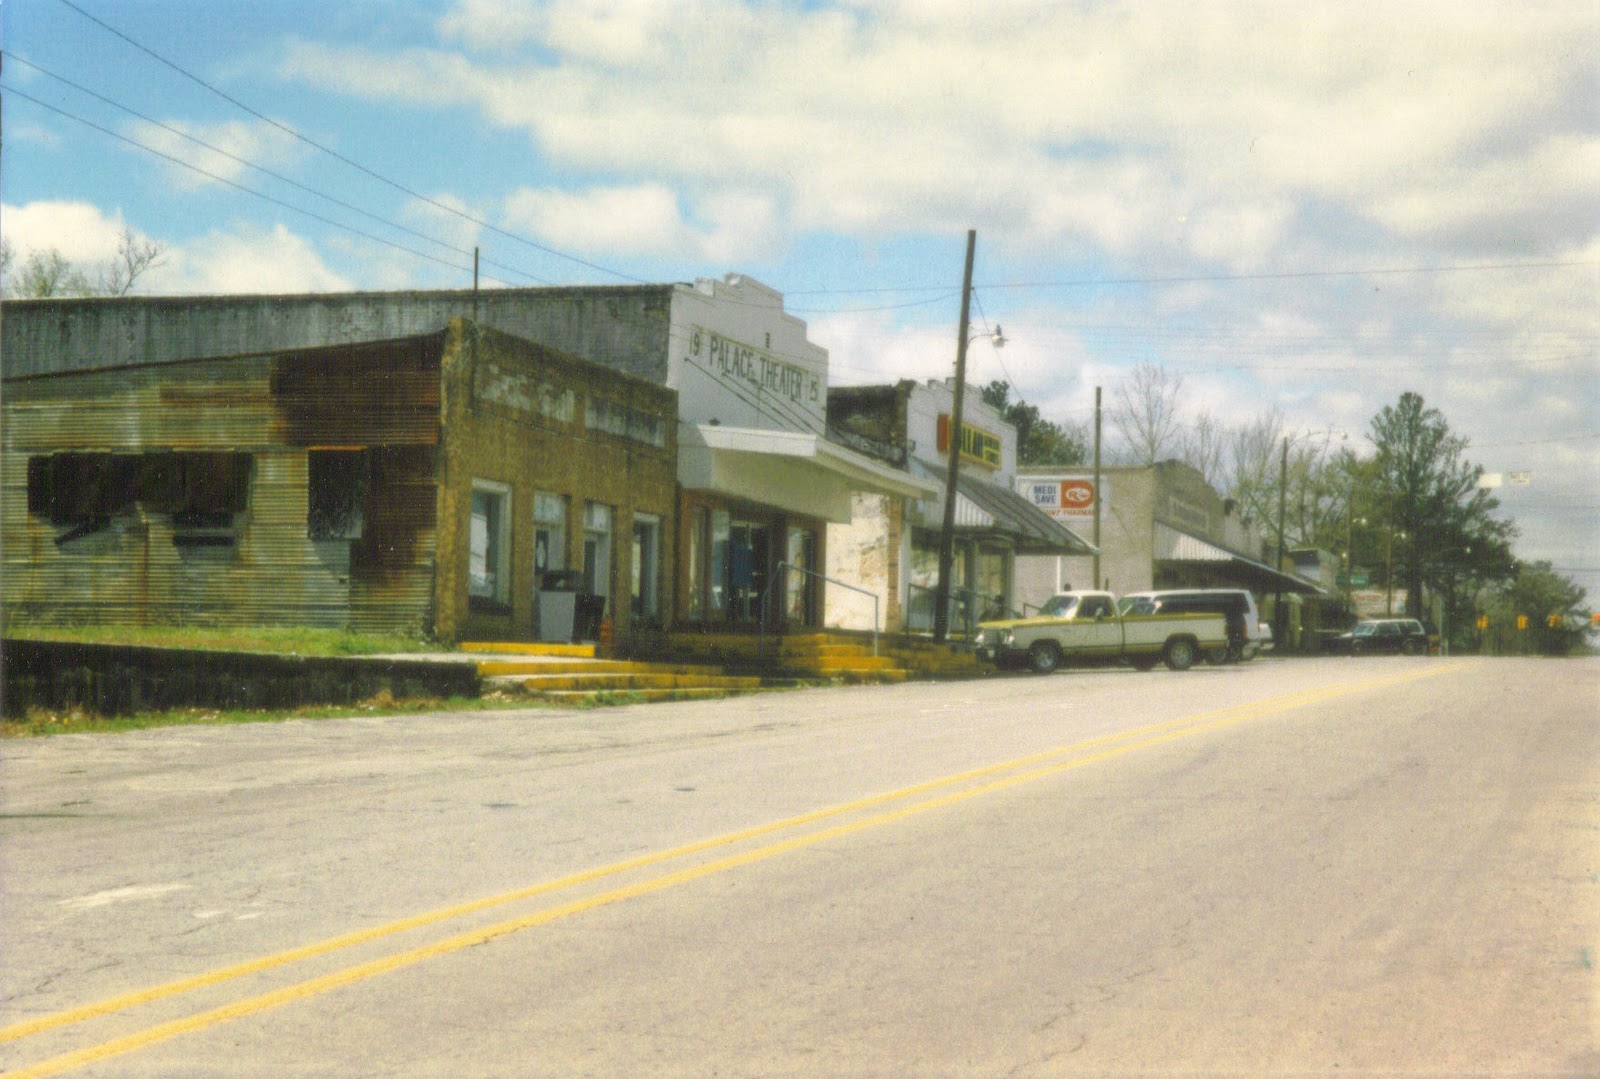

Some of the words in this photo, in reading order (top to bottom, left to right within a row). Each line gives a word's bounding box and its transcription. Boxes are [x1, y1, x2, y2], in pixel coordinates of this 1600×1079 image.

[709, 334, 754, 379] PALACE
[759, 356, 802, 402] THEATER
[1033, 485, 1056, 495] MEDI
[1034, 495, 1056, 504] SAVE
